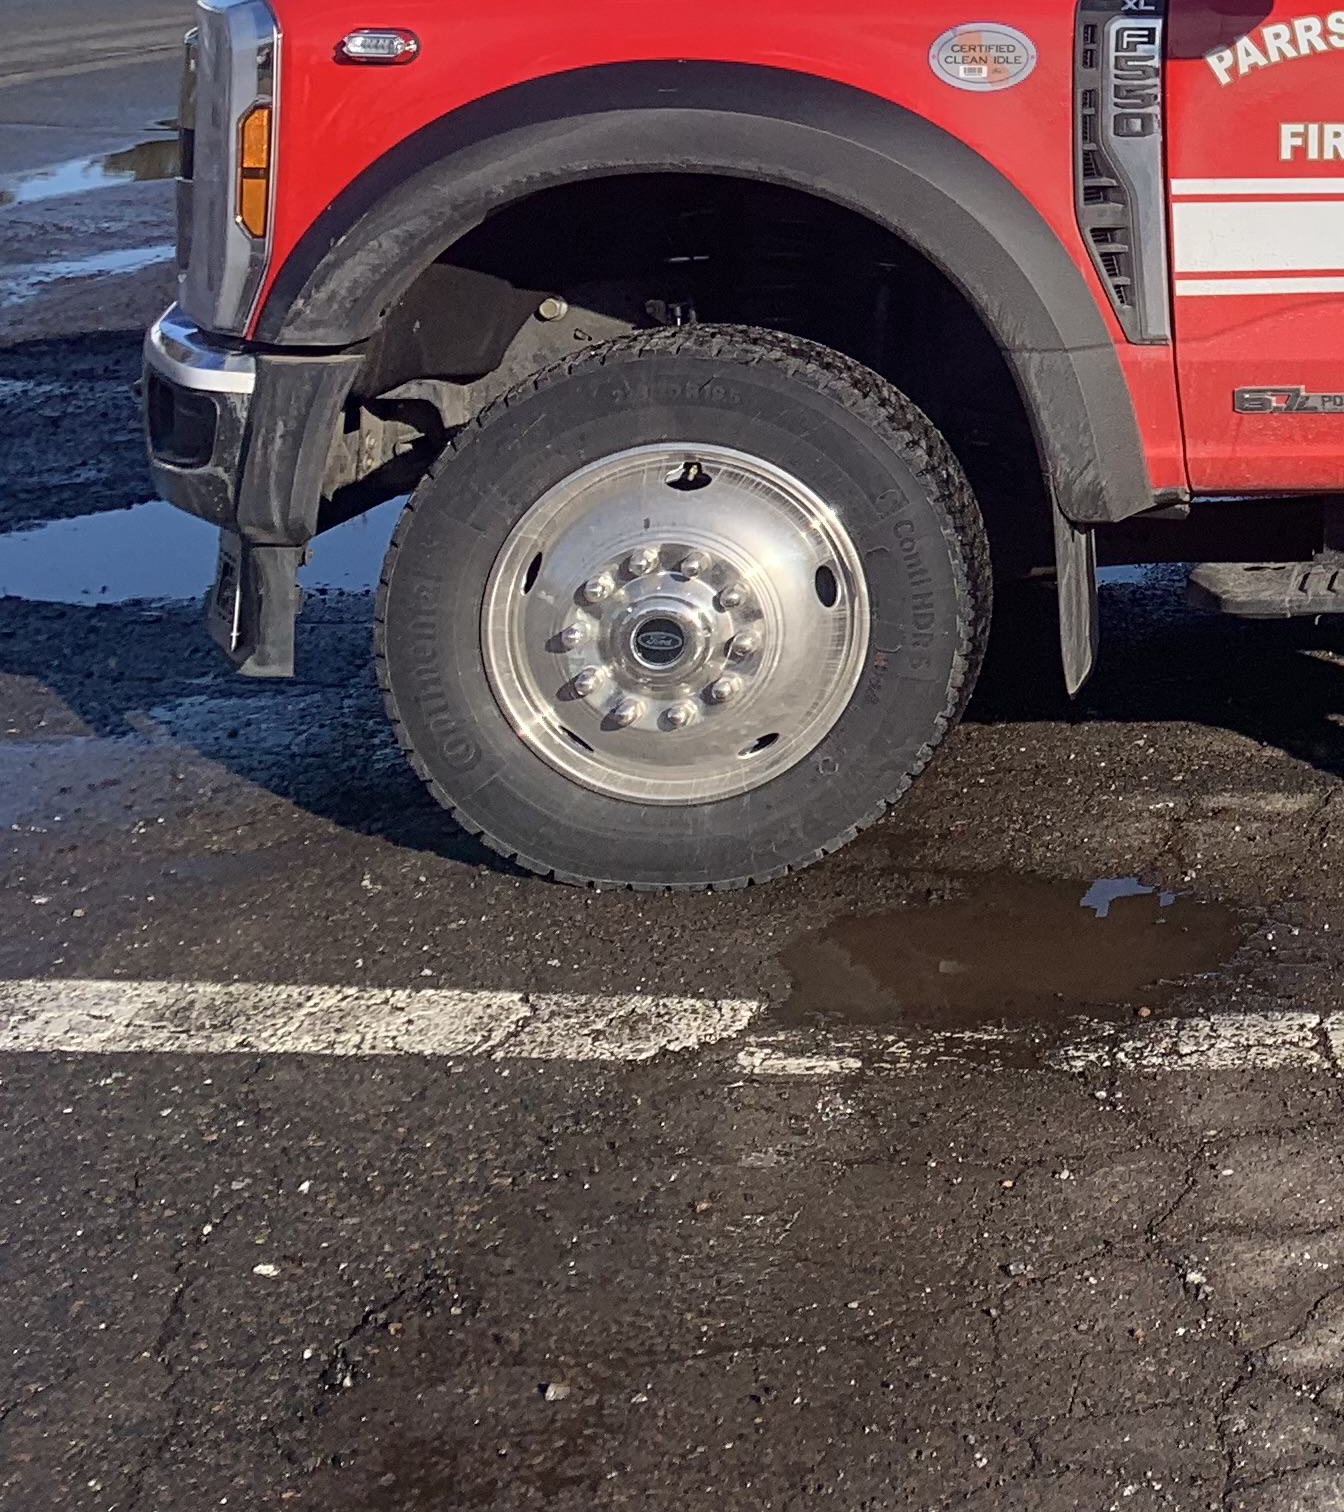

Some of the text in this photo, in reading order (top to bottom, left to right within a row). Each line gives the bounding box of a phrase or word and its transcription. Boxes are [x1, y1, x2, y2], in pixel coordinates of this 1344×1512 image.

[951, 44, 1016, 53] CERTIFIED
[944, 55, 1022, 65] CLEAN IDLE
